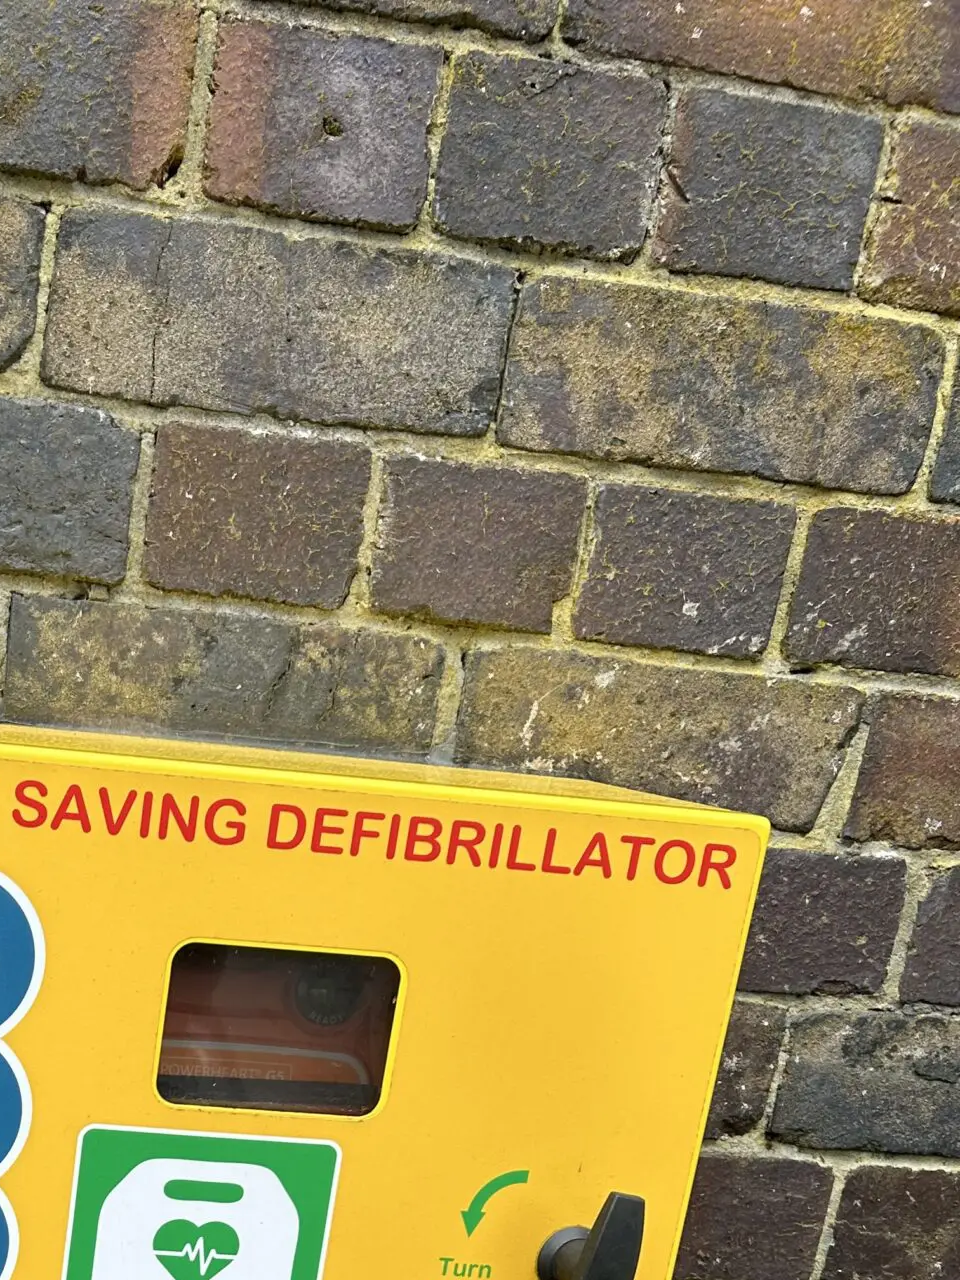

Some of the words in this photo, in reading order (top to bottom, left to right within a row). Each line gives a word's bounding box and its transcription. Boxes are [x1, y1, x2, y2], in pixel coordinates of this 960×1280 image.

[12, 780, 246, 845] SAVING
[266, 803, 737, 890] DEFIBRILLATOR
[440, 1258, 491, 1277] Turn
